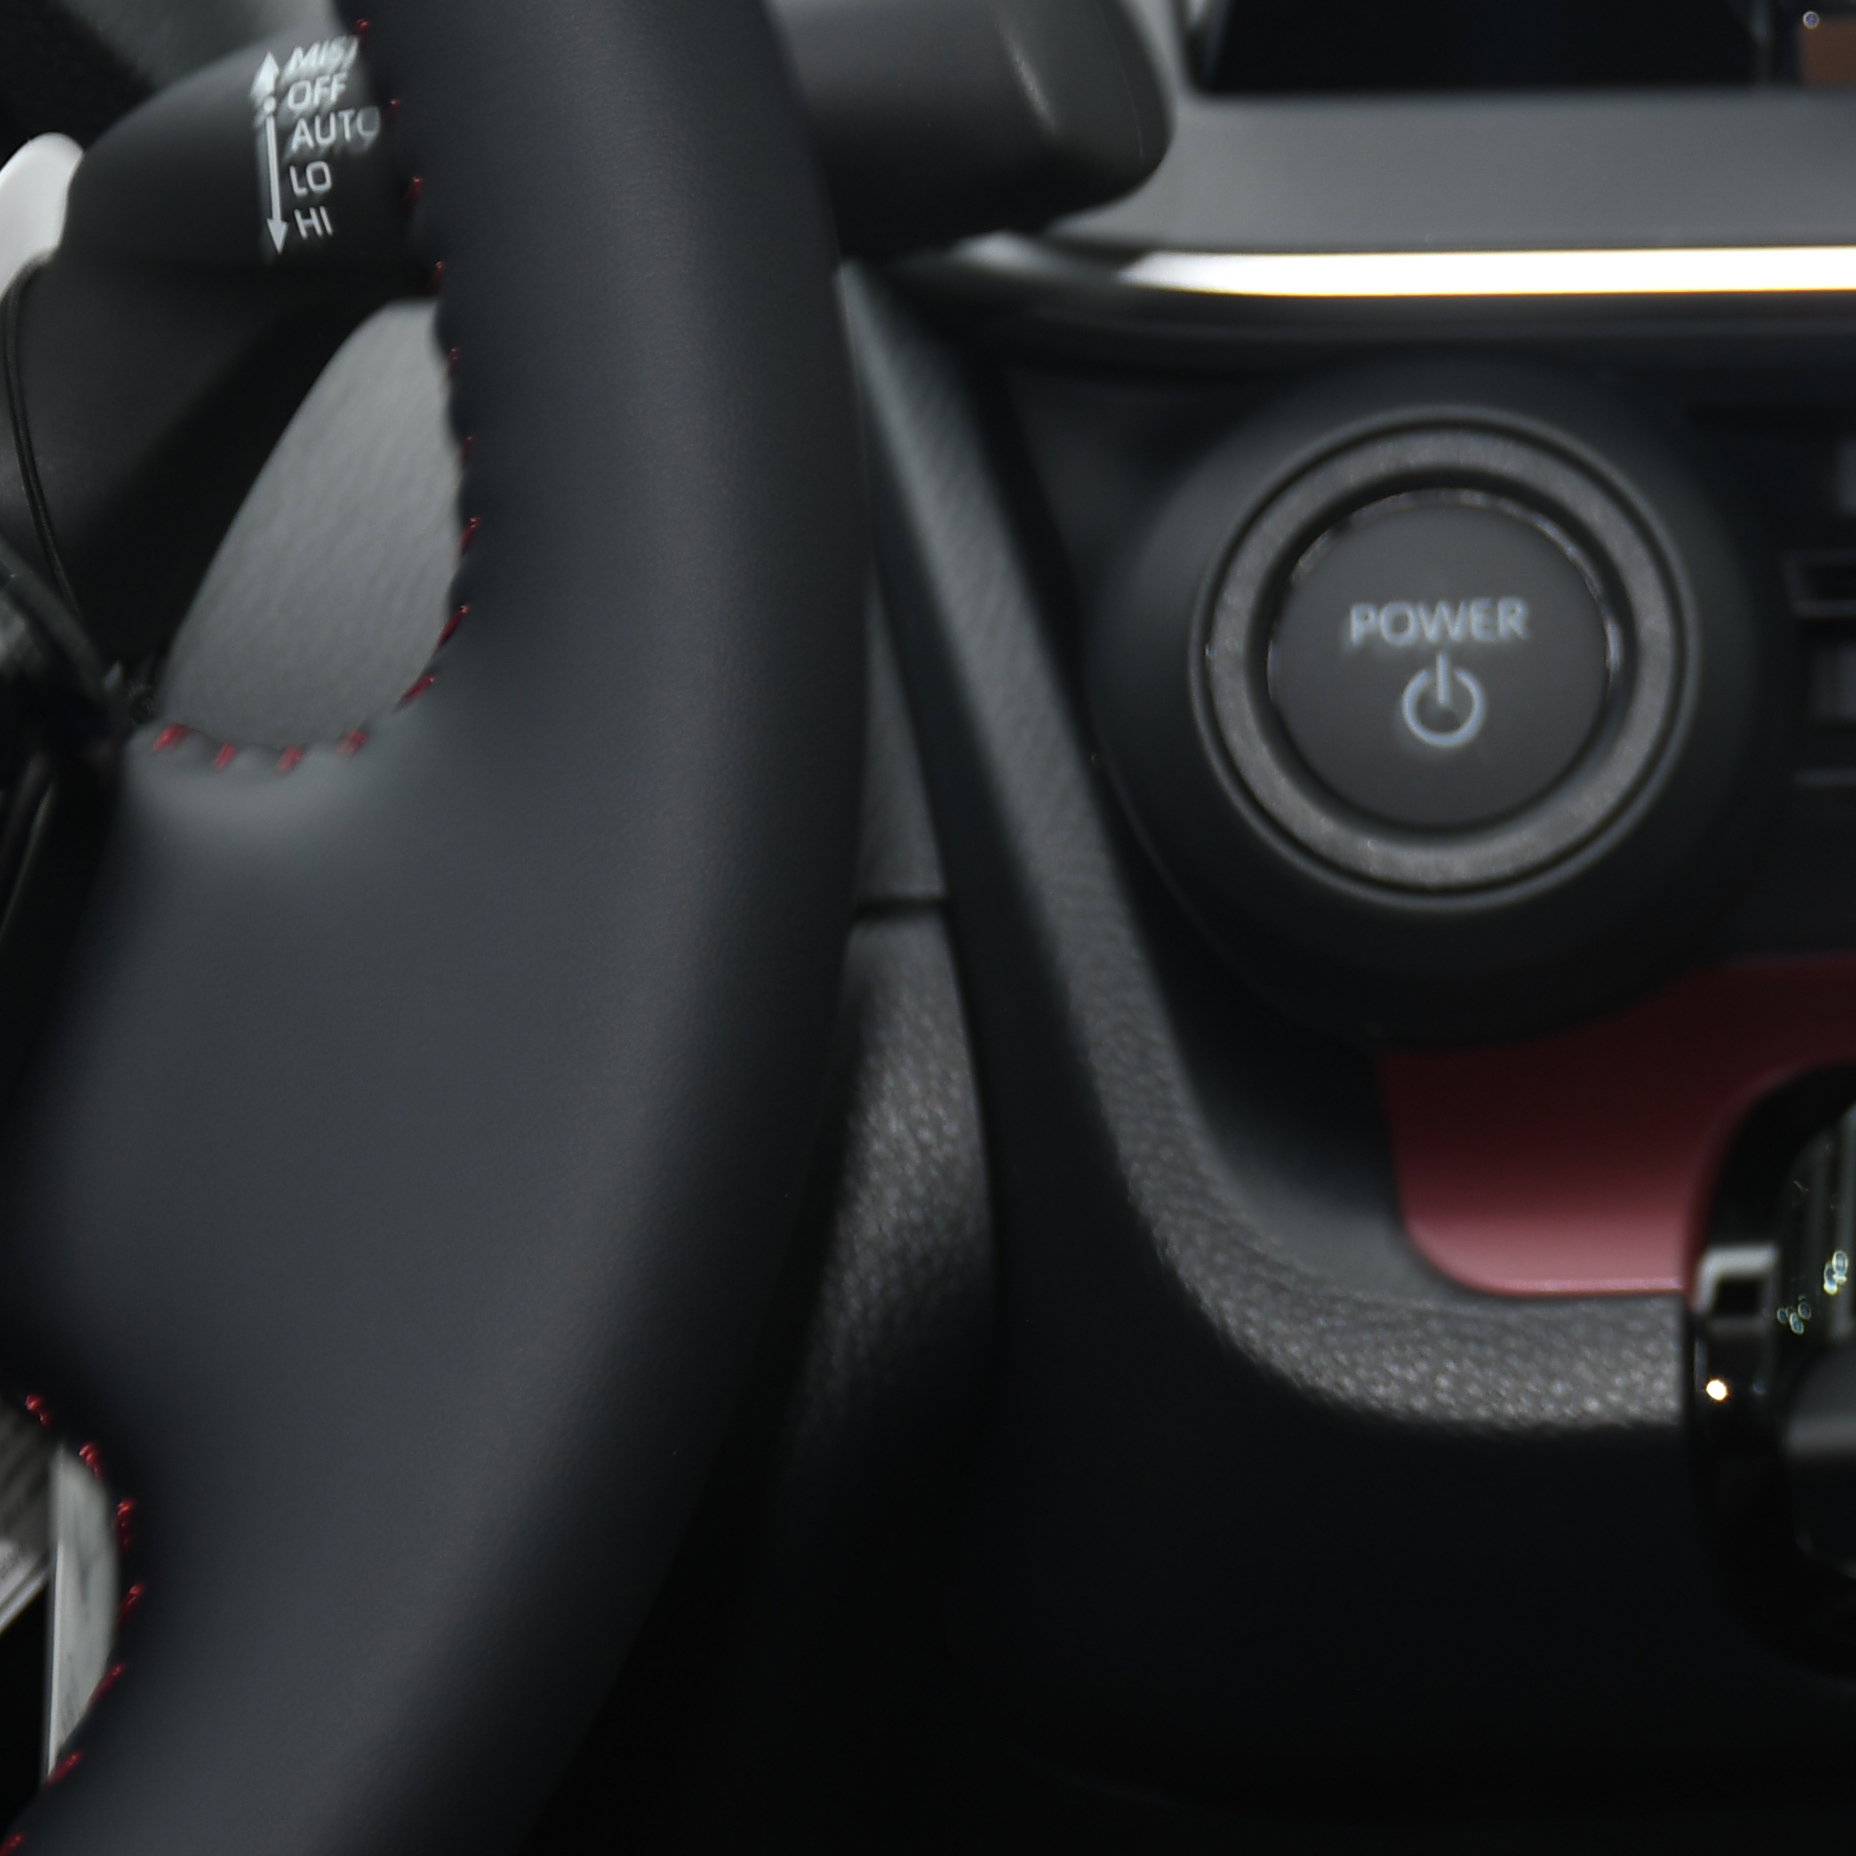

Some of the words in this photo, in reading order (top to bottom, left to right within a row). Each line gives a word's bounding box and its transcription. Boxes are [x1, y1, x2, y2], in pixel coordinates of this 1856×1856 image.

[287, 72, 348, 111] OFF
[291, 107, 381, 153] AUTO
[289, 160, 333, 198] LO
[293, 204, 335, 241] HI
[1348, 595, 1531, 645] POWER
